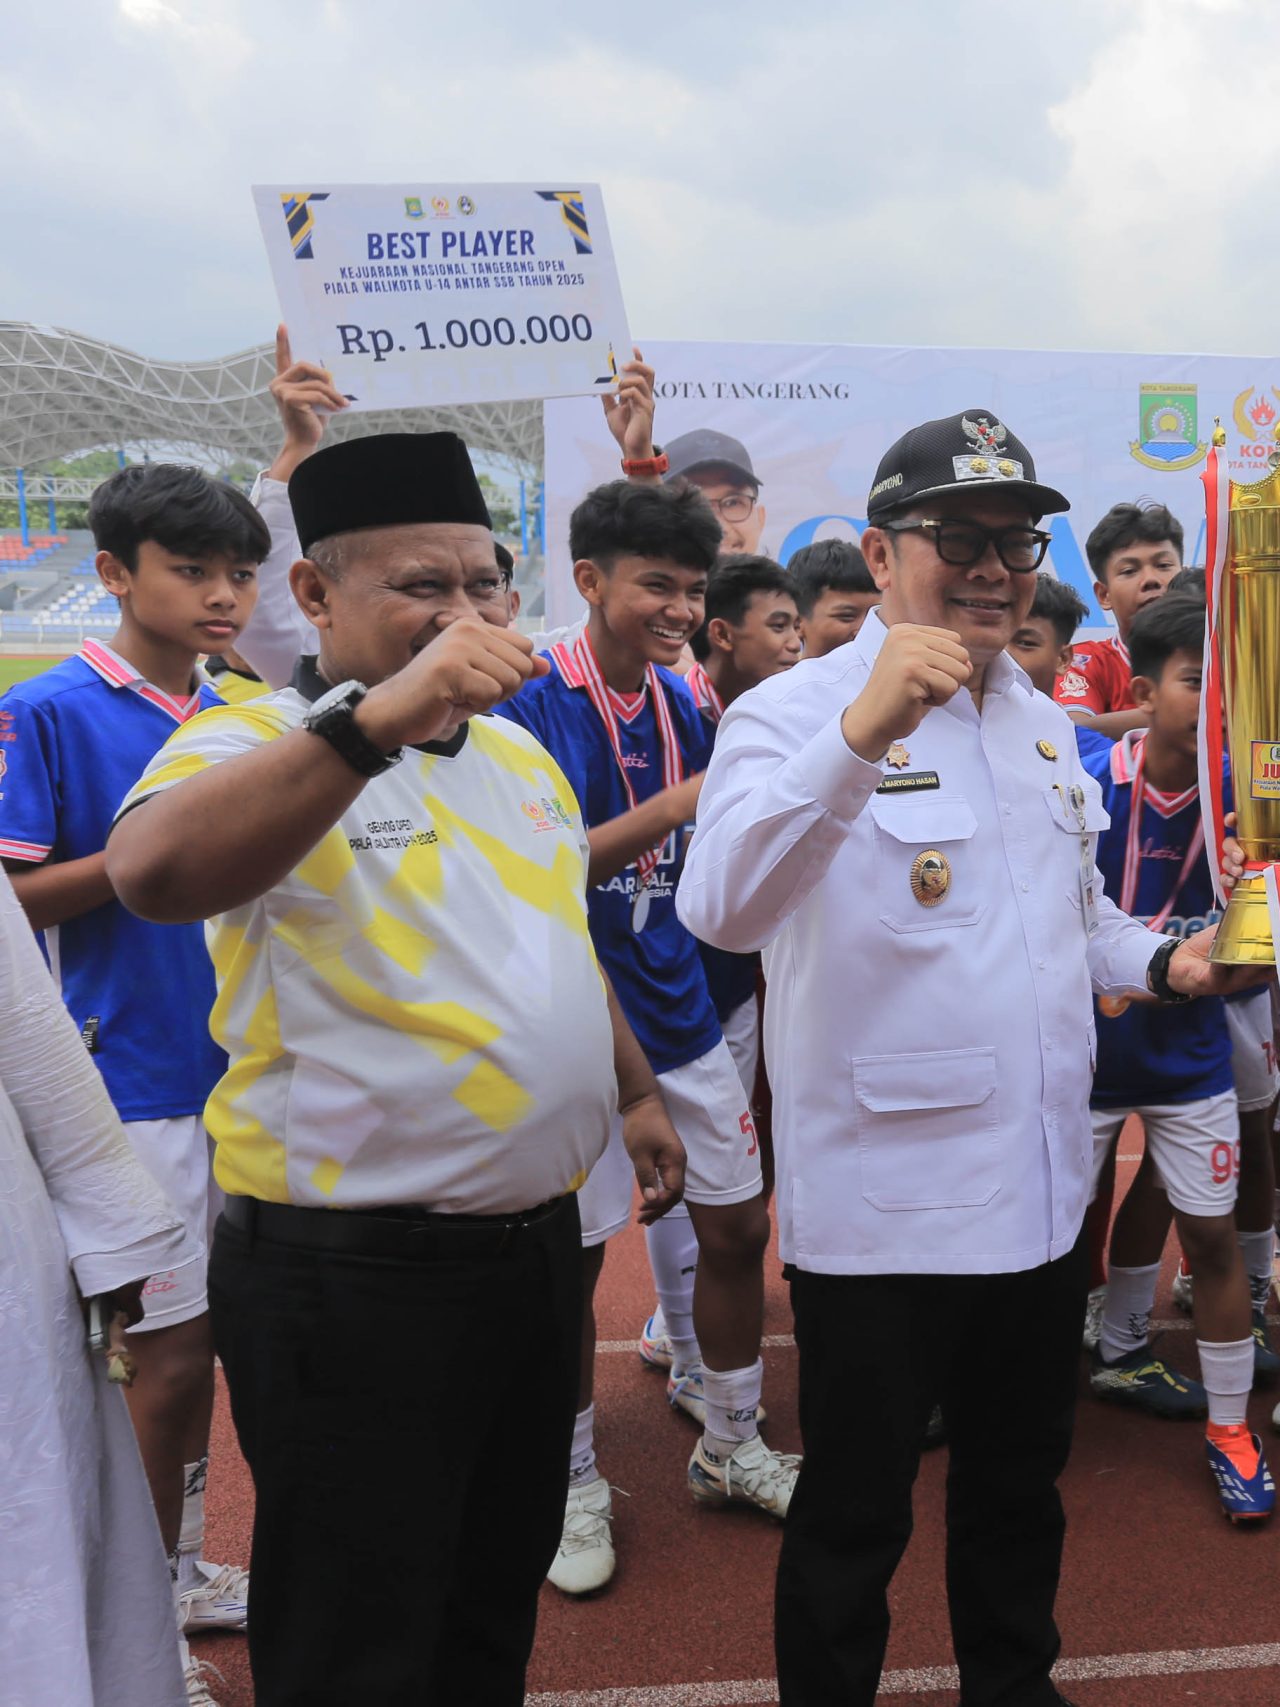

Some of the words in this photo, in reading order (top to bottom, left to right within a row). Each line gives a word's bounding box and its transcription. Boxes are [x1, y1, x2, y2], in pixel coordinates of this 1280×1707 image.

[366, 232, 431, 260] BEST
[441, 229, 536, 259] PLAYER
[340, 263, 409, 279] KEJUARAAN
[412, 262, 467, 277] NASIONAL
[471, 261, 535, 276] TANGERANG
[538, 260, 566, 273] OPEN
[324, 281, 359, 295] PIALA
[362, 279, 421, 293] WALIKOTA
[425, 277, 451, 291] U-14
[455, 276, 491, 290] ANTAR
[494, 275, 515, 288] SSB
[518, 274, 553, 288] TAHUN
[556, 273, 585, 286] 2025
[337, 324, 407, 362] Rp.
[414, 313, 593, 351] 1.000.000
[712, 382, 850, 399] TANGERANG
[1239, 444, 1280, 458] KON
[885, 779, 915, 788] MARYONO
[916, 776, 937, 785] HASAN
[416, 830, 438, 846] 2025
[738, 1110, 758, 1157] 5
